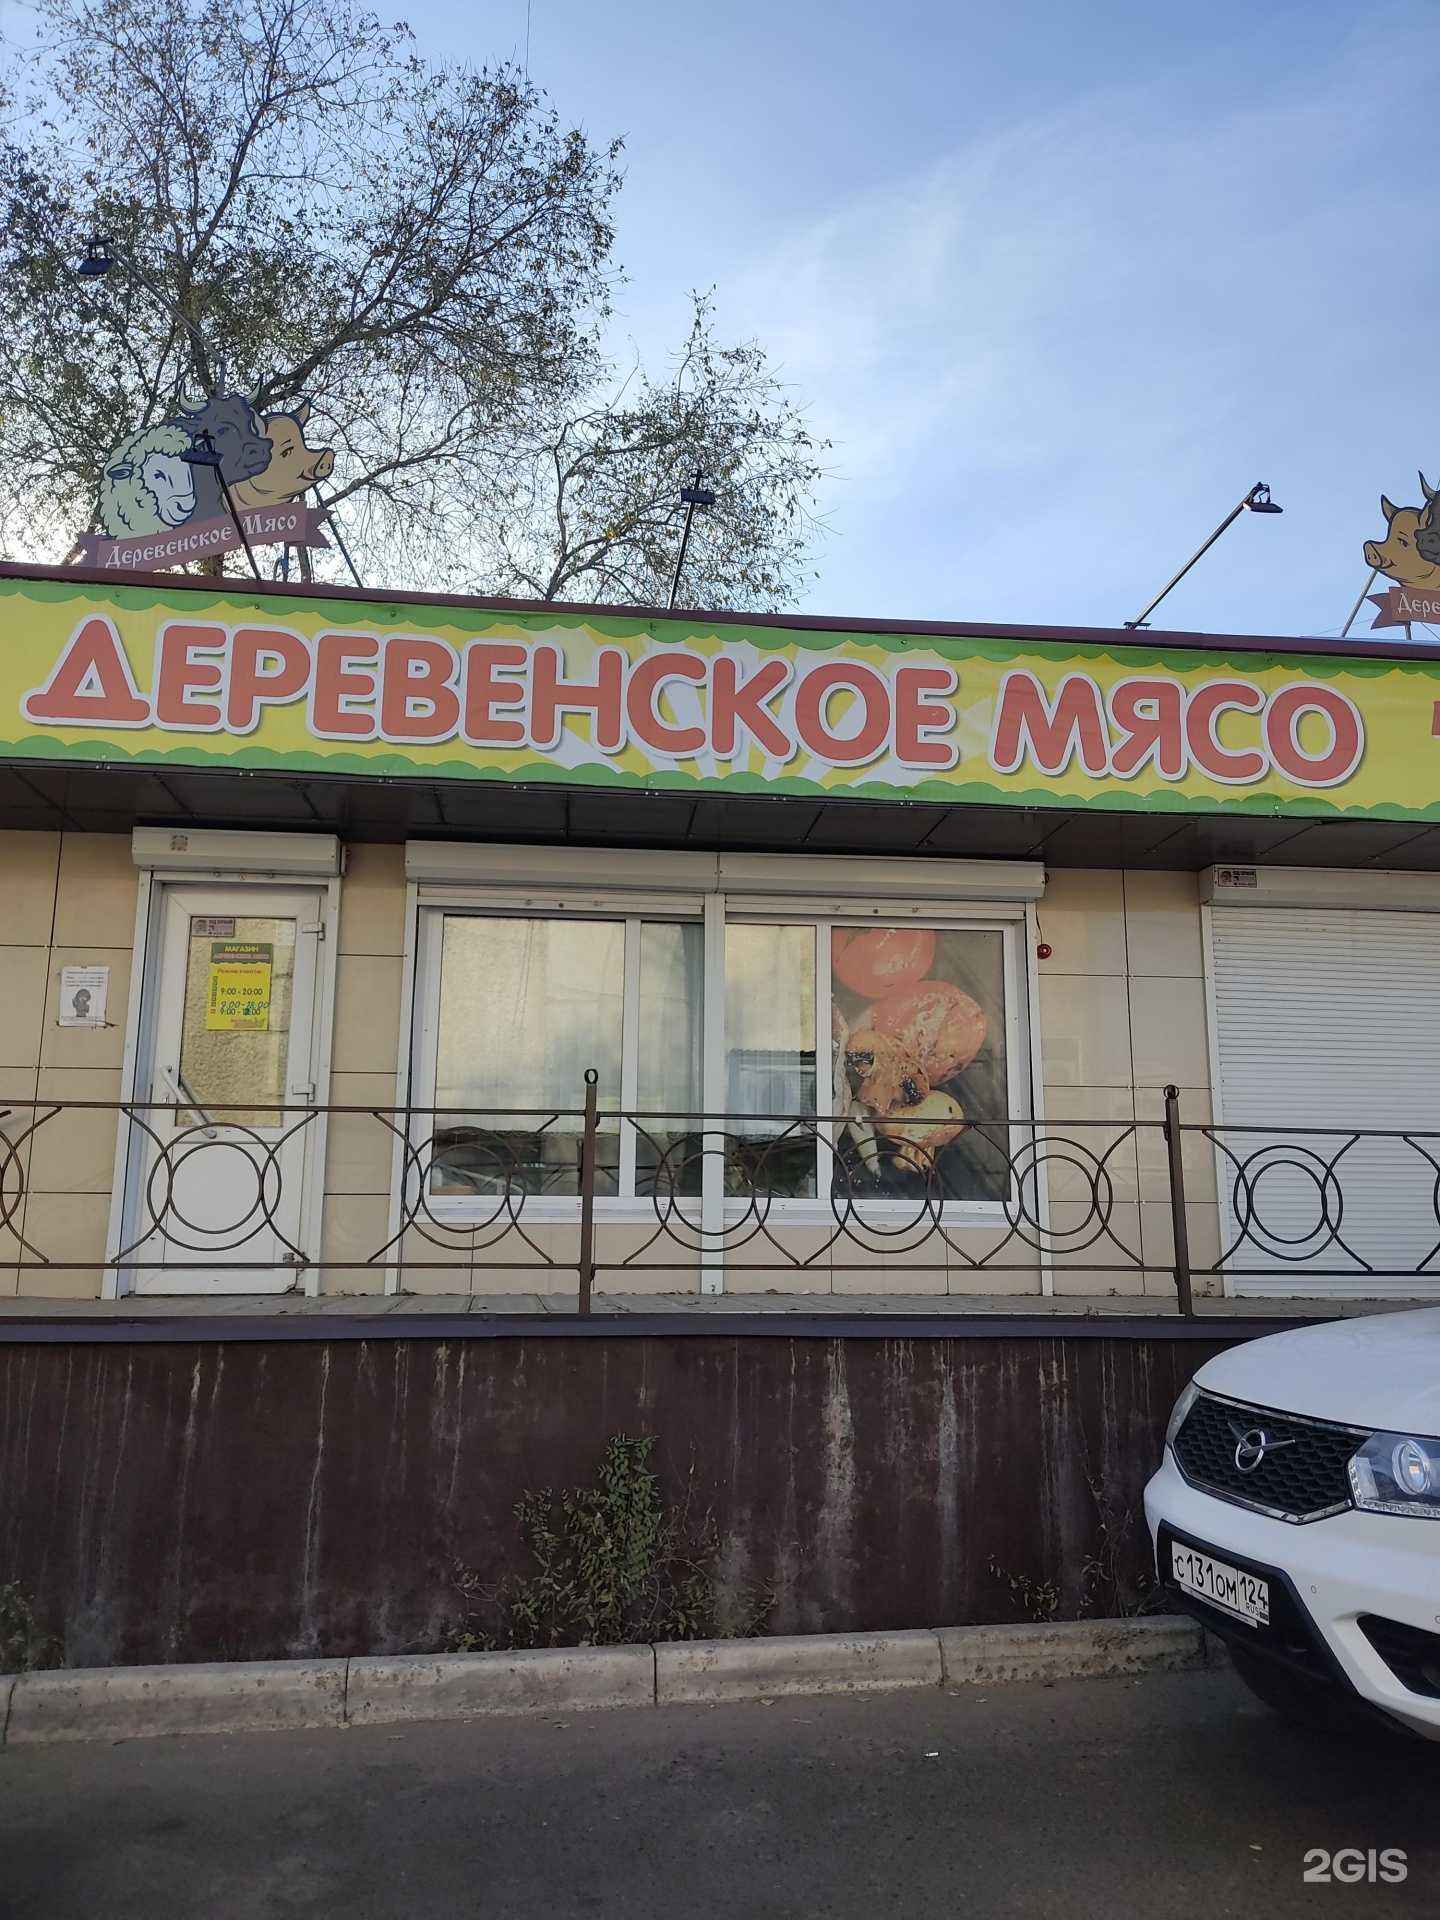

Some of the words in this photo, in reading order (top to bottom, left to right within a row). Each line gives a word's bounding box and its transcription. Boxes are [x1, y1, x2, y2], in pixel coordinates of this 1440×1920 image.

[105, 525, 233, 569] Деревенское
[242, 513, 298, 536] Мясо
[22, 614, 958, 769] ДЕРЕВЕНСКОЕ
[992, 672, 1363, 786] МЯСО
[224, 945, 259, 953] МАГАЗИН
